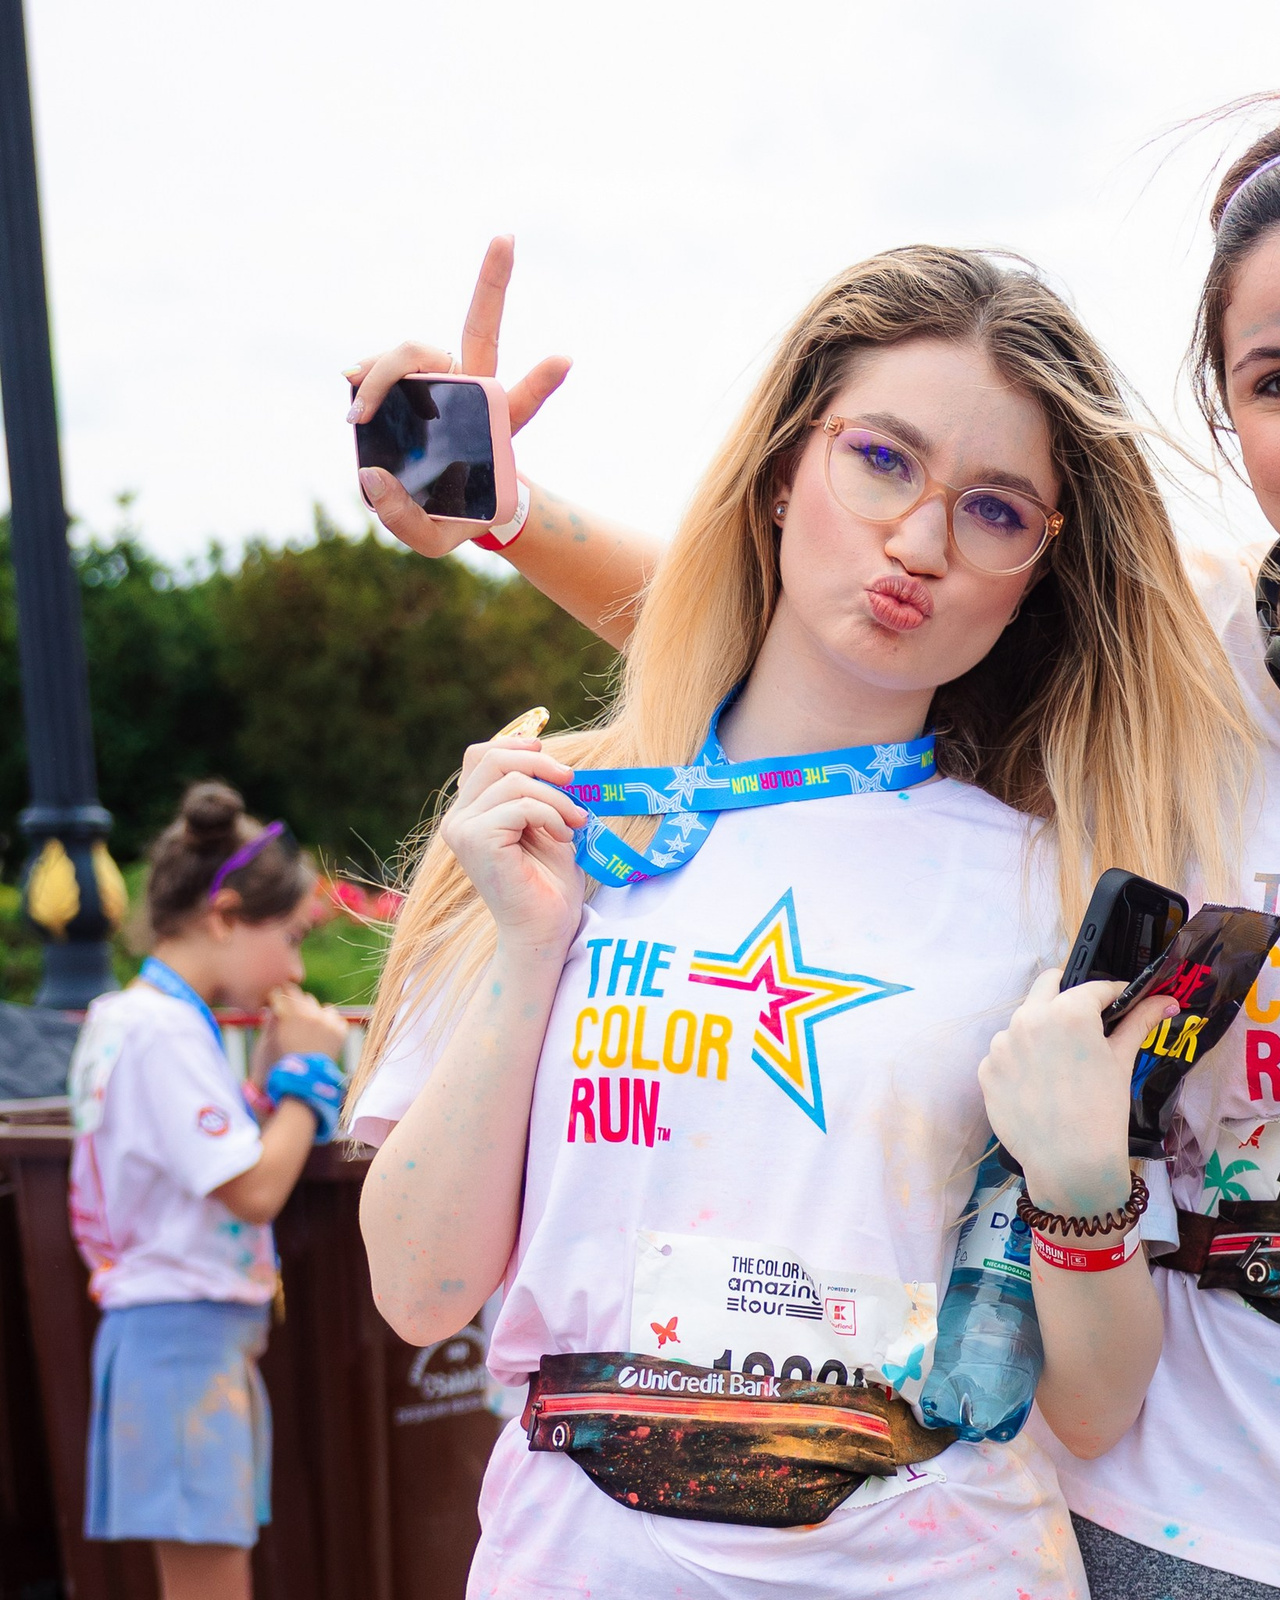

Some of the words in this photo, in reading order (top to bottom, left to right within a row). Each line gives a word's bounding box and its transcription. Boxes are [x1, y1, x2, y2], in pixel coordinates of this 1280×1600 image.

[731, 774, 759, 795] RUN
[759, 768, 803, 790] COLOR
[803, 766, 830, 786] THE
[602, 784, 626, 802] THE
[606, 854, 633, 880] THE
[586, 938, 676, 998] THE
[572, 1004, 733, 1082] COLOR
[567, 1077, 660, 1148] RUN
[732, 1256, 754, 1274] THE
[757, 1259, 799, 1279] COLOR
[986, 1260, 1032, 1278] NECARBOGAZOA
[740, 1295, 784, 1315] tour
[639, 1368, 724, 1394] UniCredit
[729, 1374, 781, 1397] Bank
